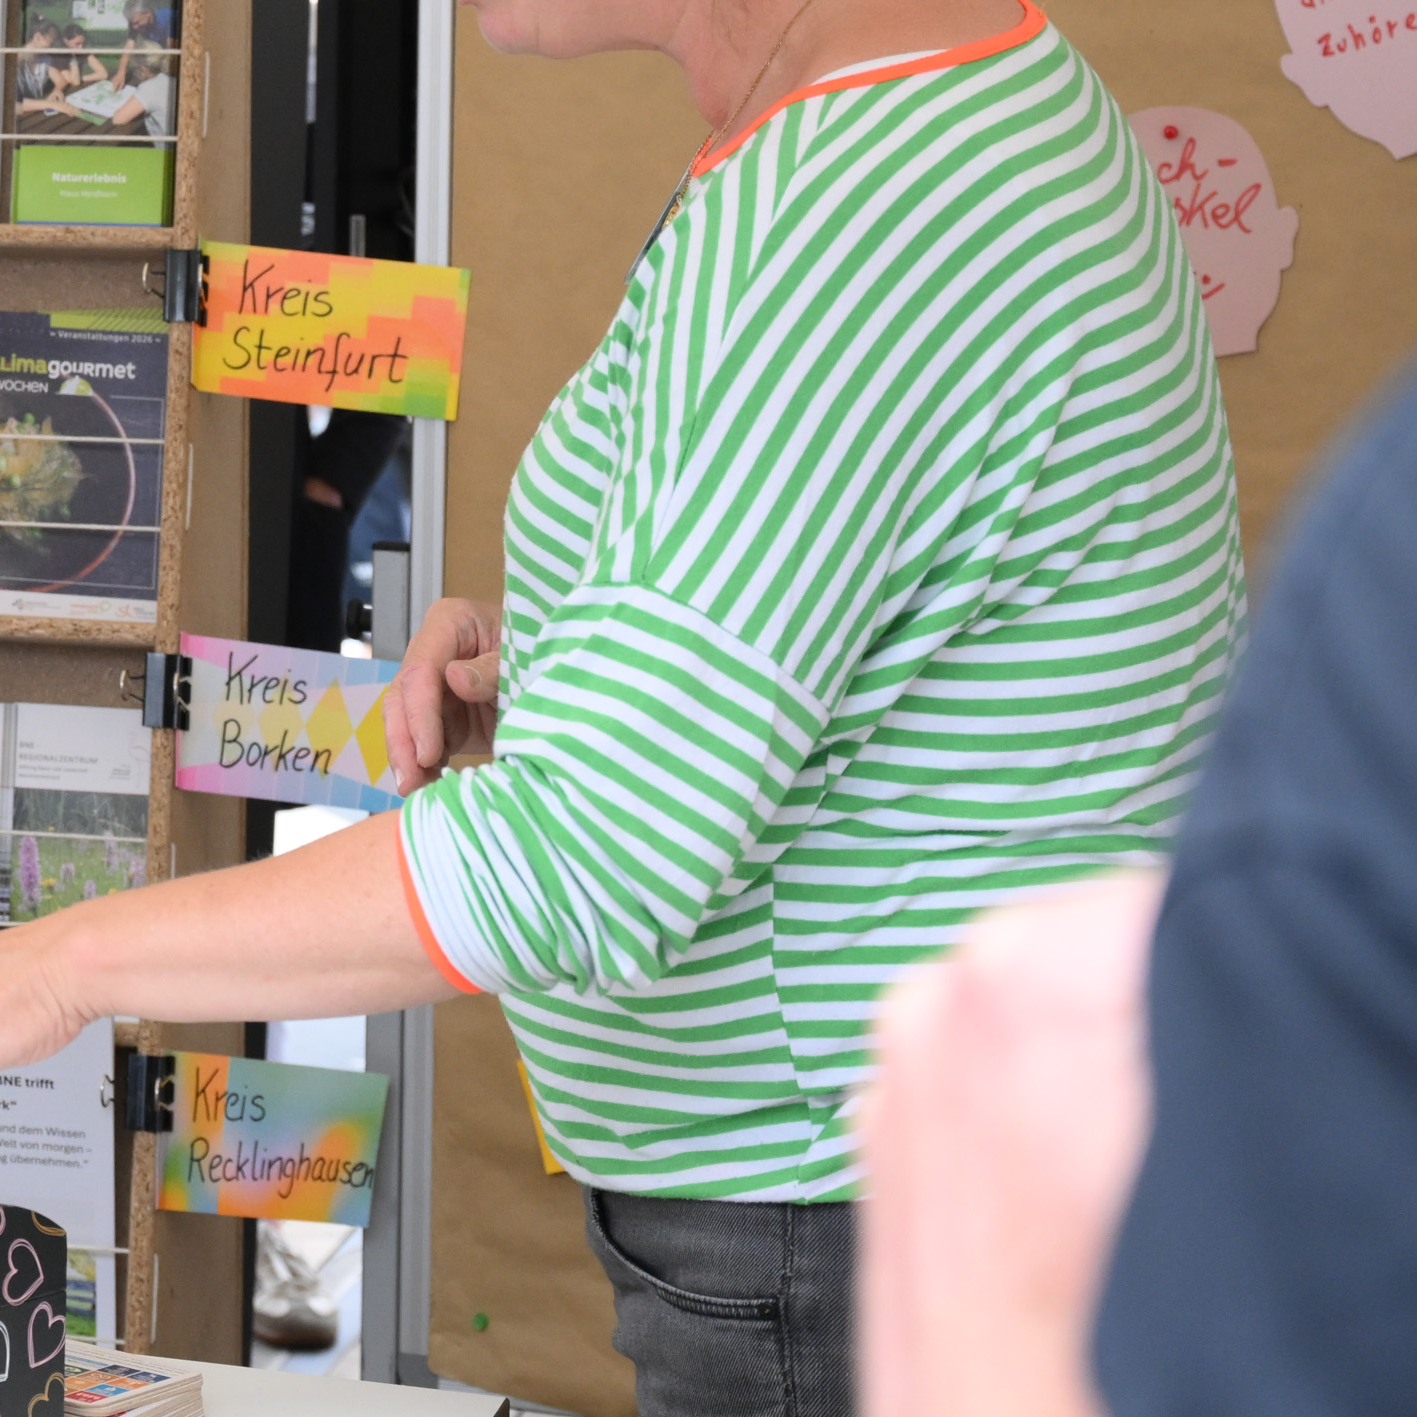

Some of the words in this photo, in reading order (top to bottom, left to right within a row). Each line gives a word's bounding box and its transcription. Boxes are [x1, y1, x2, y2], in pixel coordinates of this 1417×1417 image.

[51, 172, 127, 184] Naturerlebnis
[237, 258, 335, 318] Kreis
[130, 334, 153, 344] 2026
[222, 325, 409, 393] Steinfurt
[225, 651, 308, 706] Kreis
[219, 718, 333, 775] Borken
[24, 1077, 55, 1090] trifft
[192, 1066, 267, 1124] Kreis
[18, 1124, 43, 1135] dem
[44, 1126, 87, 1139] Wissen
[19, 1140, 40, 1150] von
[41, 1142, 85, 1156] morgen
[9, 1152, 90, 1169] übernehmen.“
[187, 1136, 374, 1200] Recklinghausen
